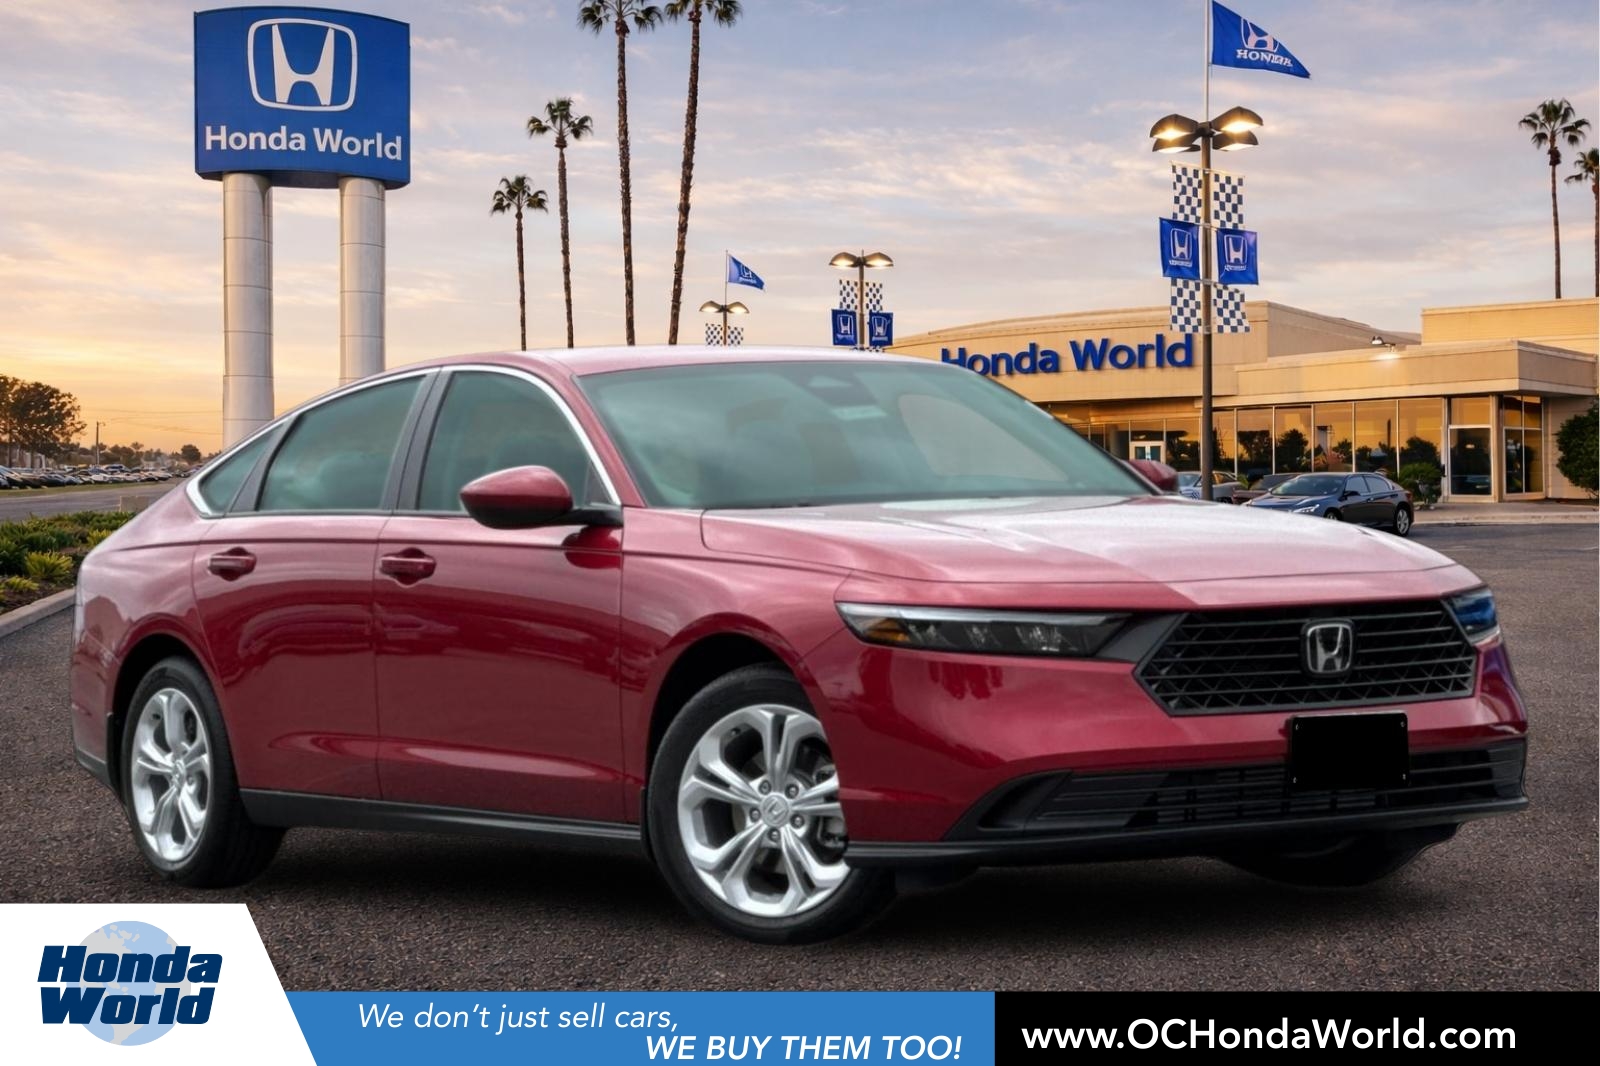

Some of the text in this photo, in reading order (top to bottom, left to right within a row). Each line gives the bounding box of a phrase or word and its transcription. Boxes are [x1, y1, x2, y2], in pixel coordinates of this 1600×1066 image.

[205, 125, 402, 160] Honda World
[941, 333, 1194, 376] Honda World
